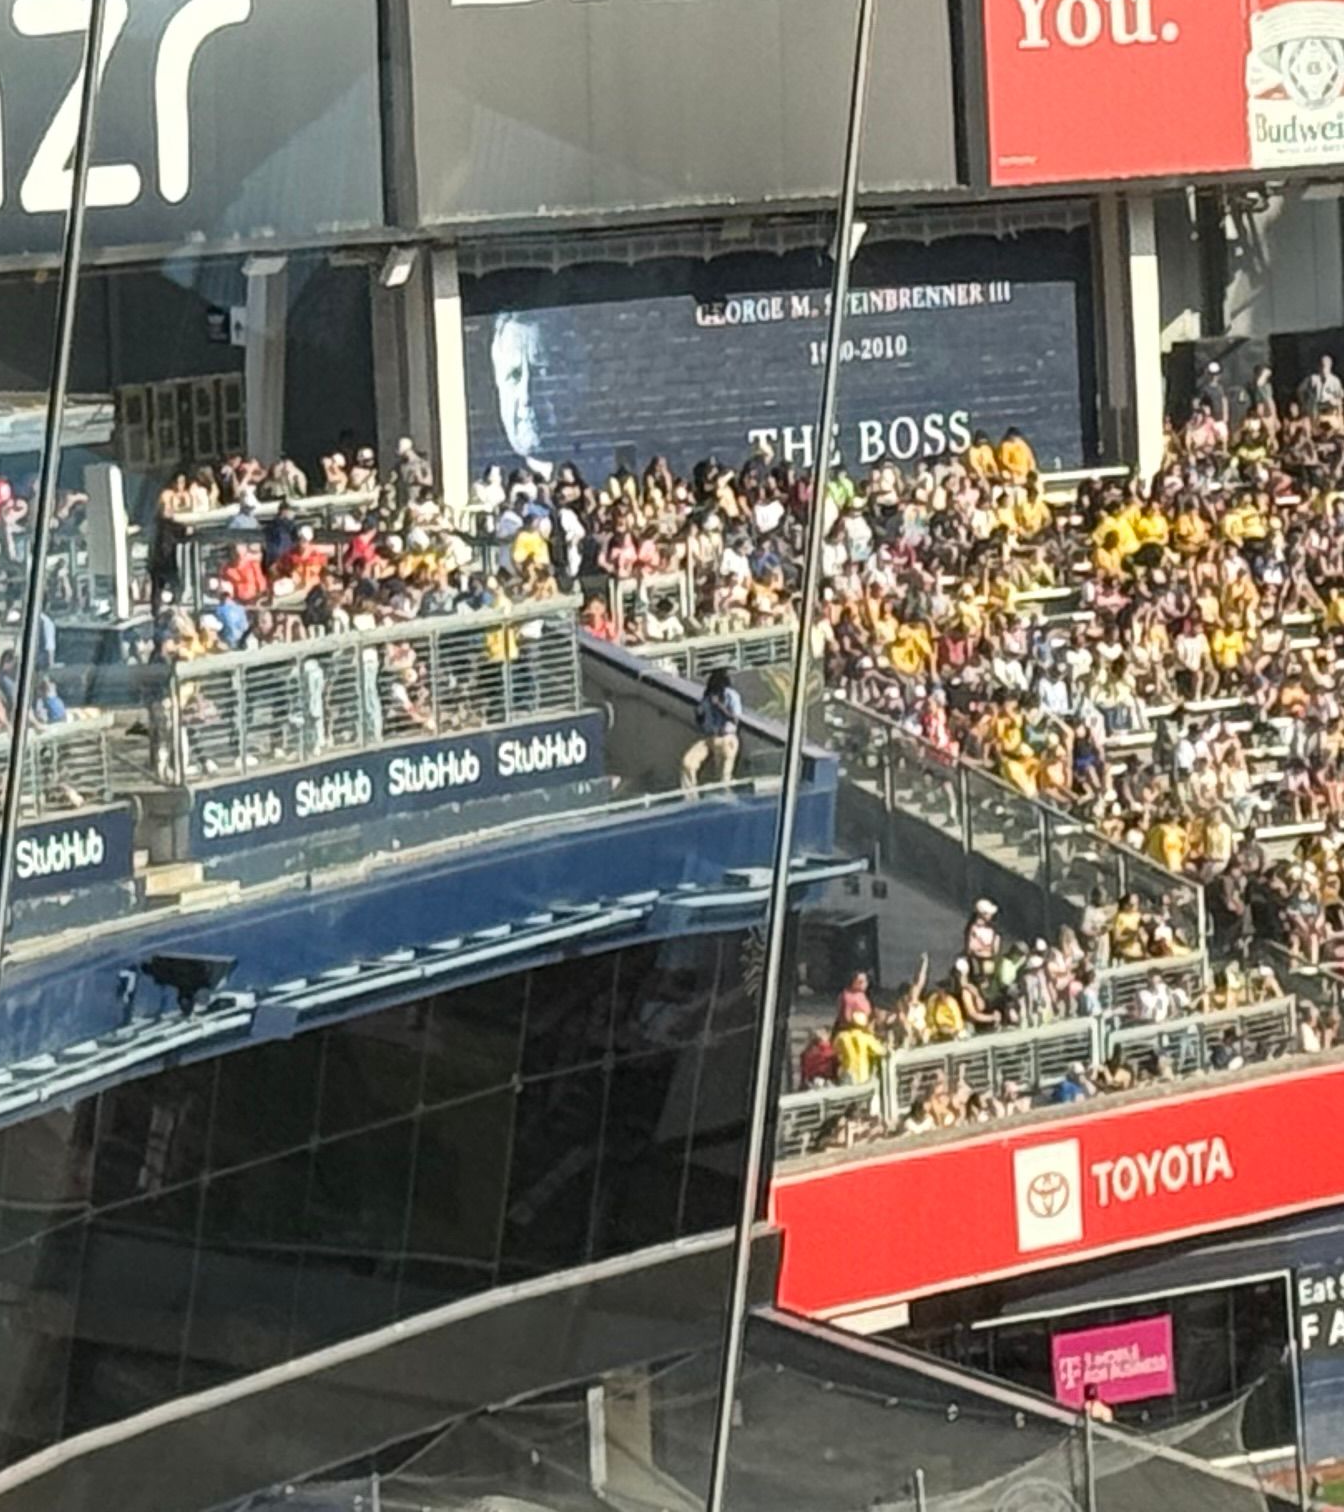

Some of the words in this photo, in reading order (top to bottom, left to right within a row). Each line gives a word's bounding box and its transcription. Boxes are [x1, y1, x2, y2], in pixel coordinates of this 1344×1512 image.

[824, 282, 984, 316] SEINBRENNER
[859, 410, 972, 464] BOSS
[203, 790, 281, 839] StubHub
[295, 769, 373, 817] StubHub
[388, 748, 481, 795] StubHub
[498, 728, 587, 776] StubHub
[16, 826, 105, 879] StubHub
[1091, 1136, 1235, 1207] TOYOTA
[1298, 1276, 1337, 1306] Eat
